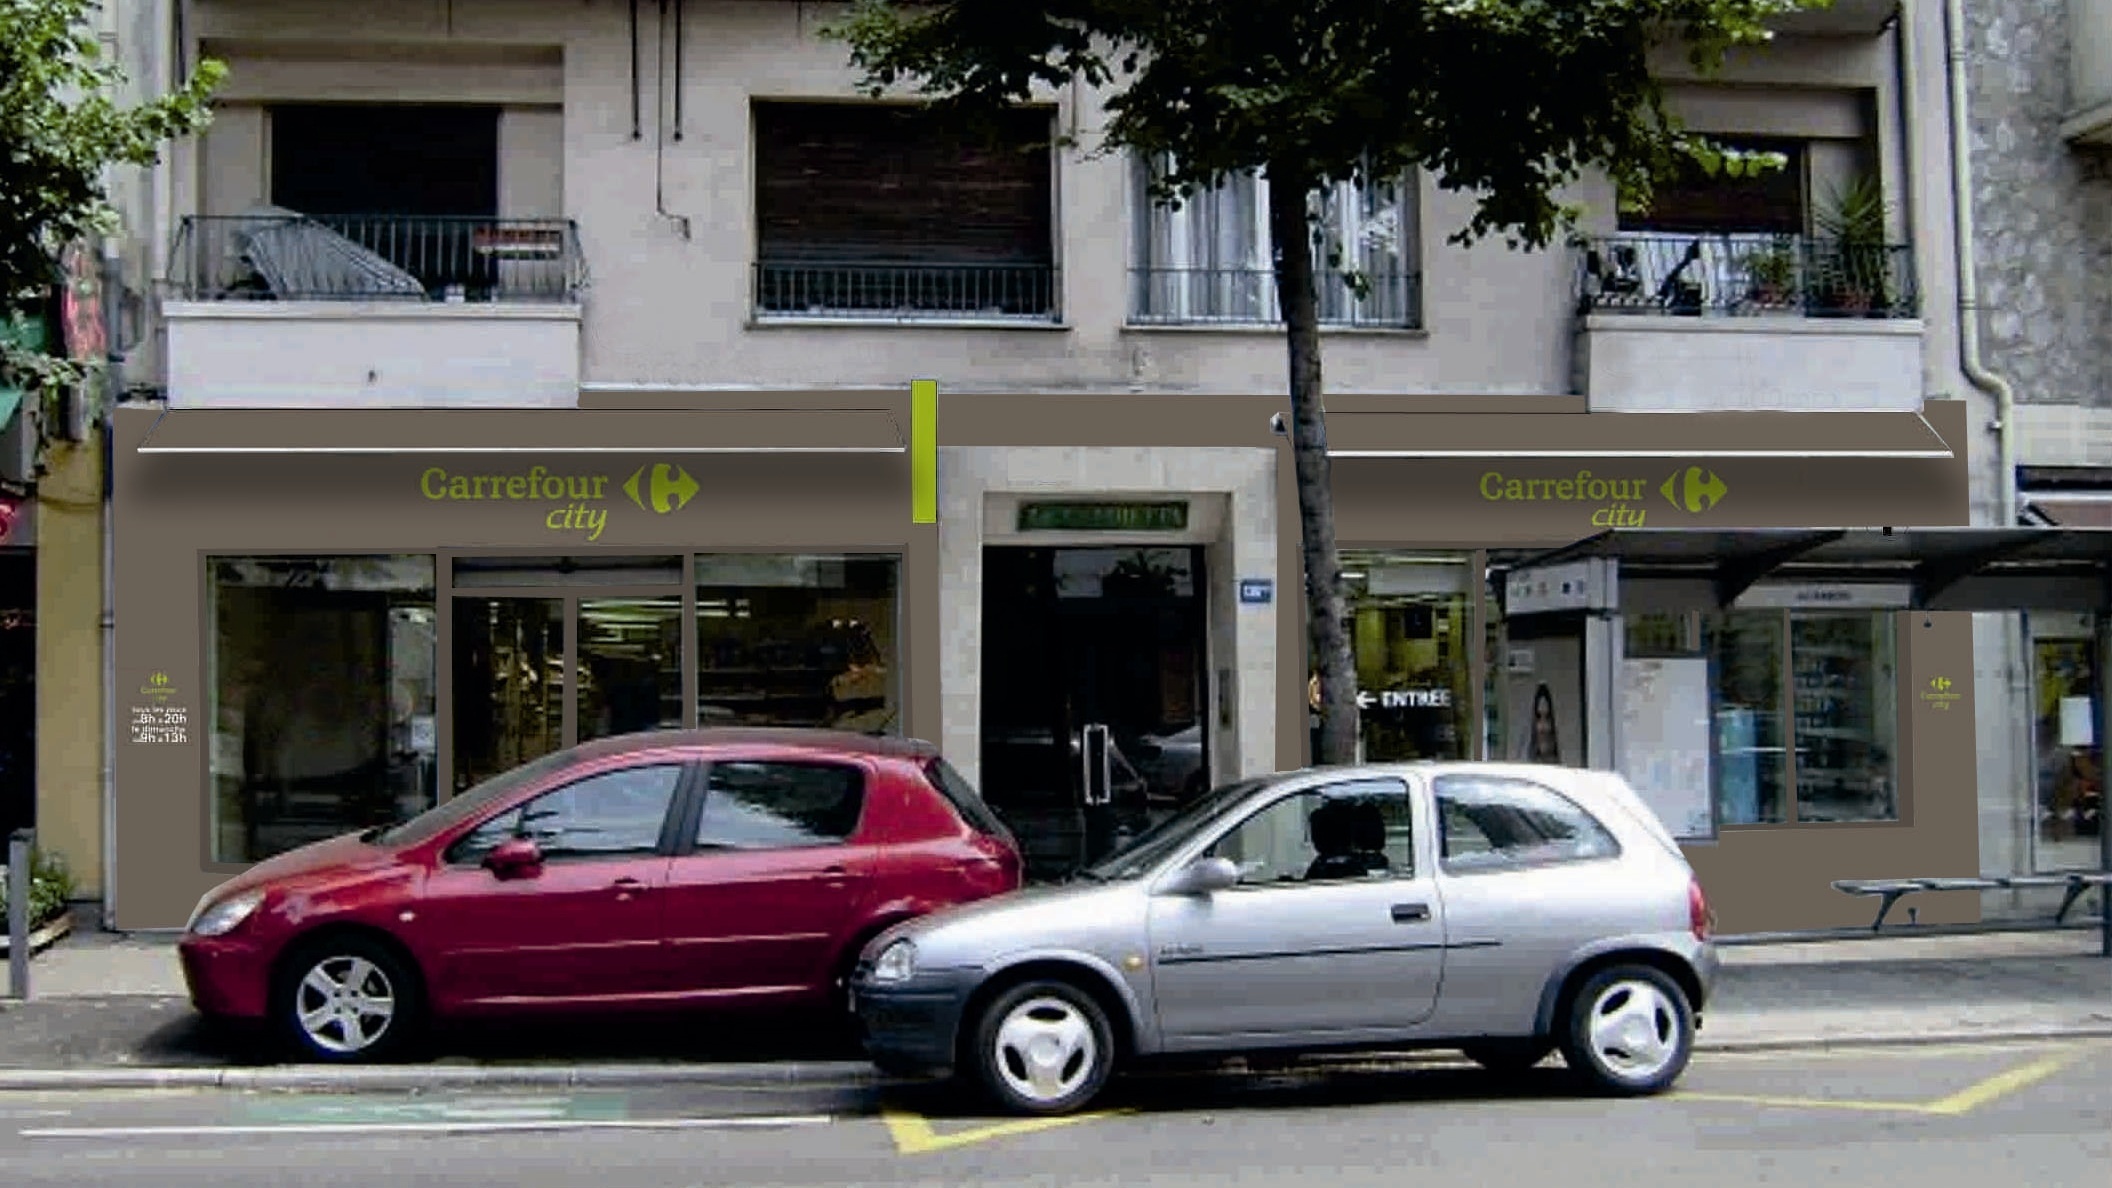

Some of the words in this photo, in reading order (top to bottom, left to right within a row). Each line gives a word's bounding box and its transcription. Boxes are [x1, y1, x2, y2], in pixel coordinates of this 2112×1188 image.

[420, 465, 608, 500] Carrefour
[1479, 470, 1647, 500] Carrefour
[546, 502, 608, 541] city
[1591, 503, 1646, 527] city
